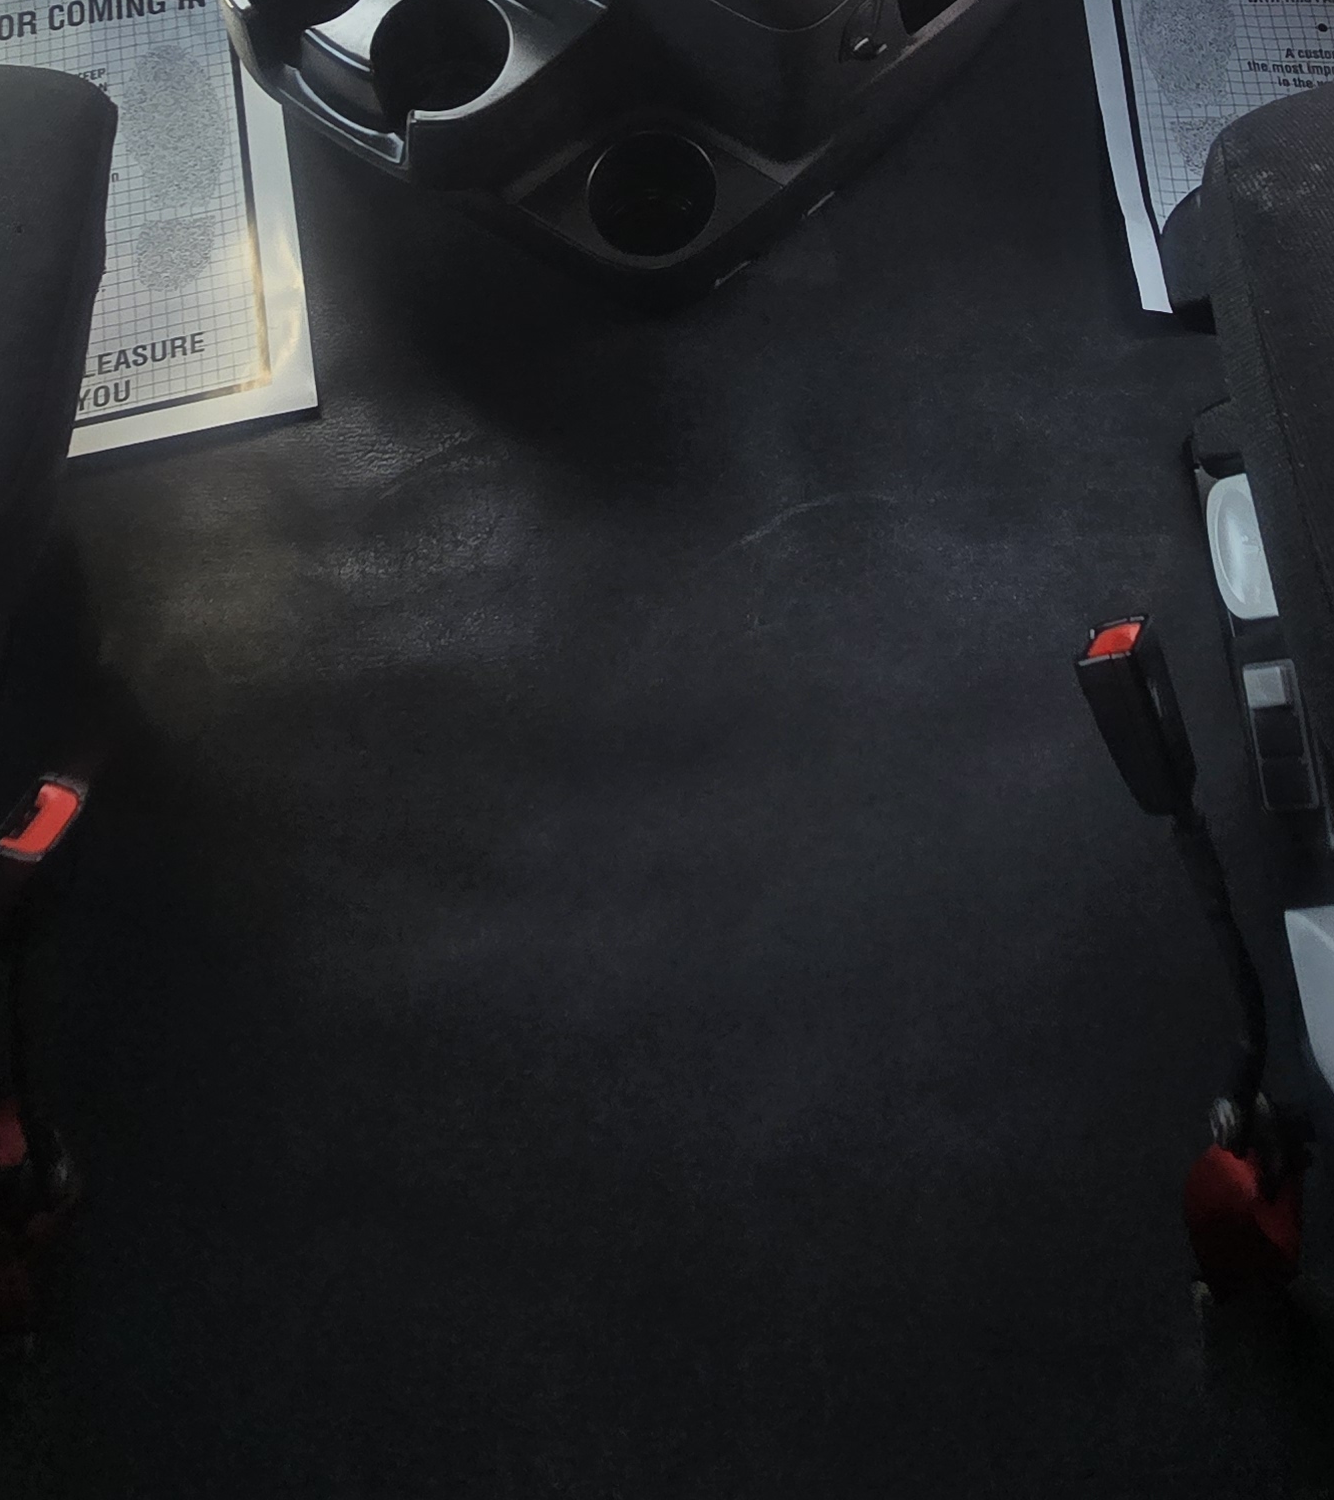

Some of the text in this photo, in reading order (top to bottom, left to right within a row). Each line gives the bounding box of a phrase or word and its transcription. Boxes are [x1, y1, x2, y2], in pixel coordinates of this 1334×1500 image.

[1284, 47, 1295, 59] A
[1246, 61, 1267, 72] the
[1272, 63, 1305, 74] most
[1293, 78, 1314, 89] the
[78, 379, 131, 411] YOU
